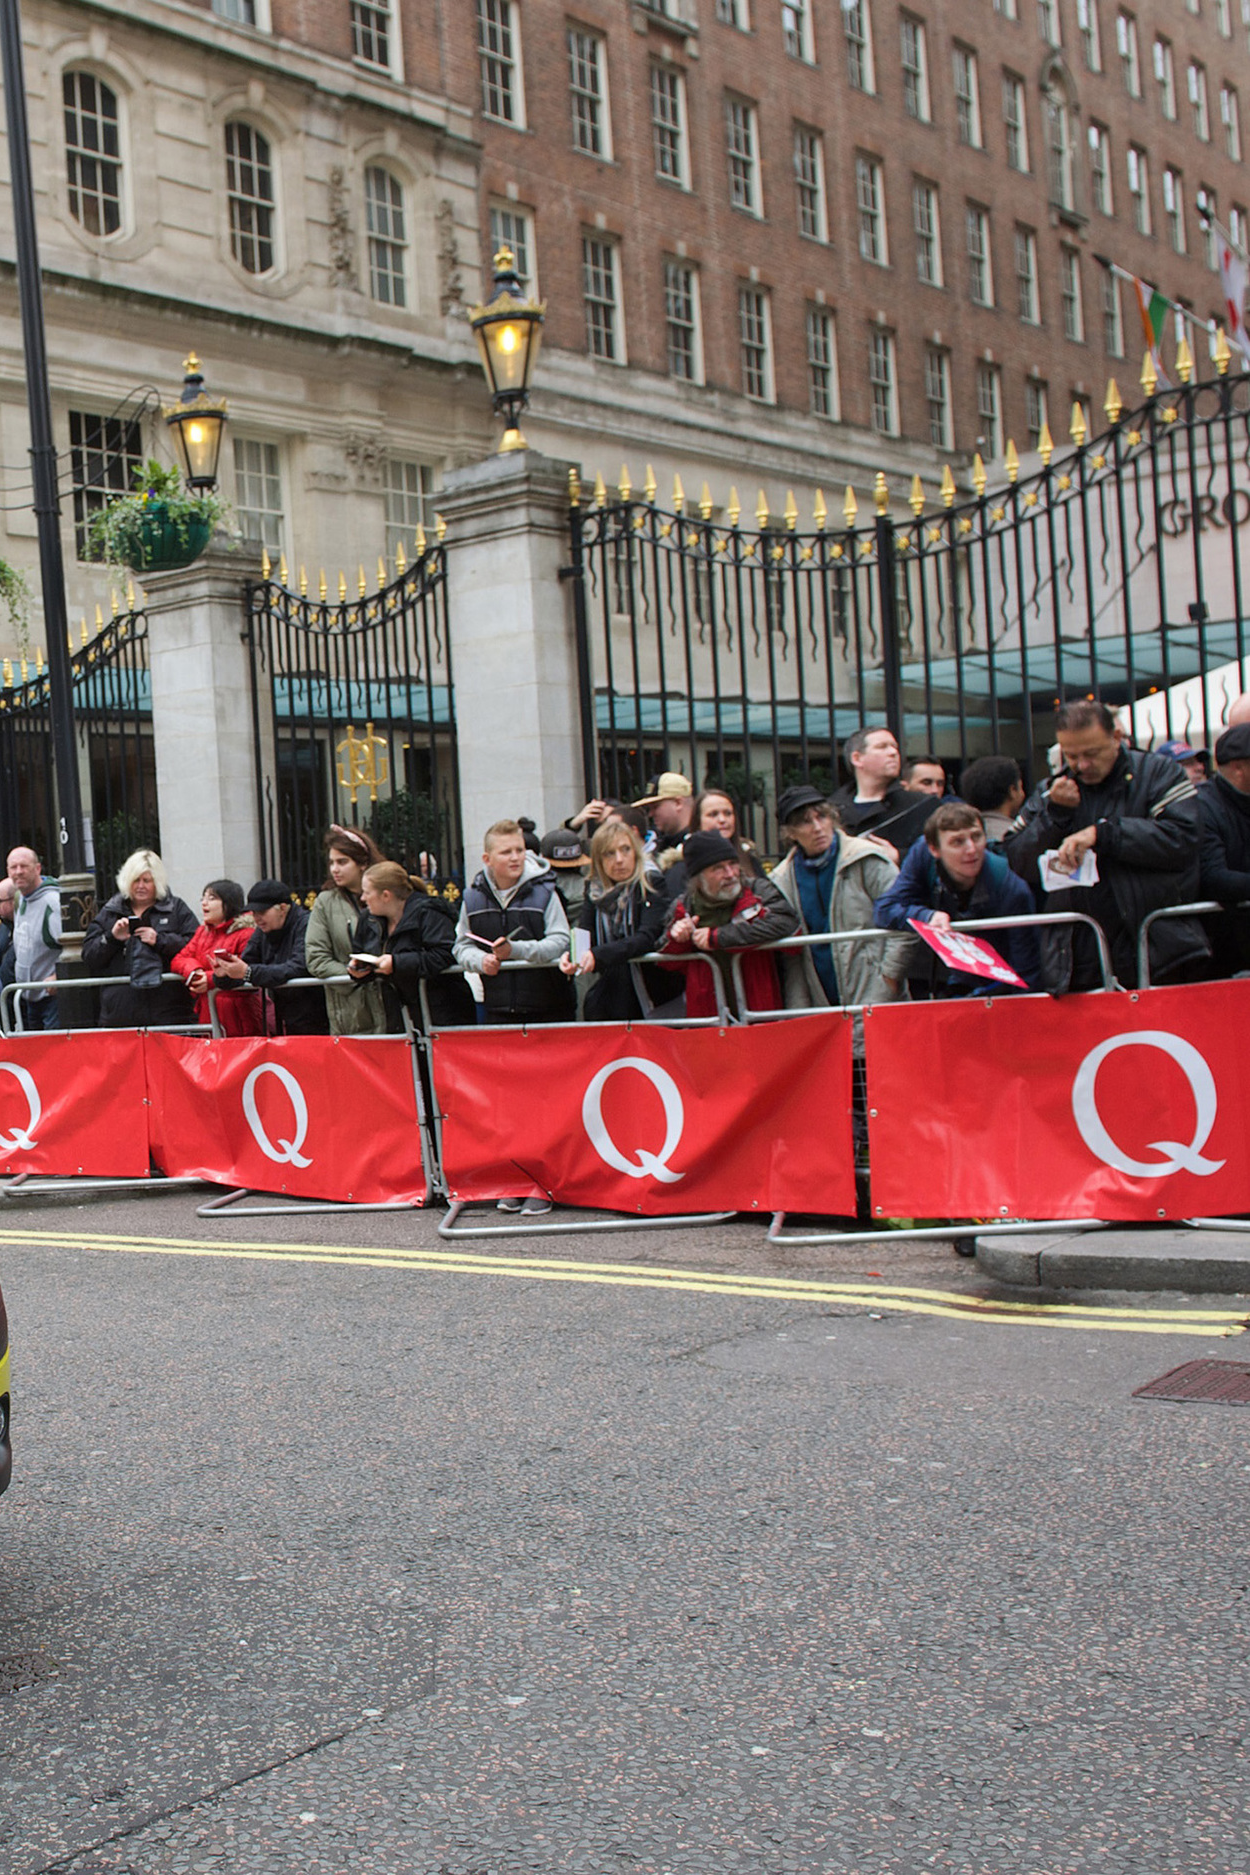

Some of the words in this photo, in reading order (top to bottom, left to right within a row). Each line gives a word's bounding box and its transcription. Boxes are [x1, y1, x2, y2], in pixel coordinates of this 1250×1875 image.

[242, 1062, 313, 1168] Q
[582, 1056, 686, 1183] Q
[1072, 1030, 1227, 1177] Q
